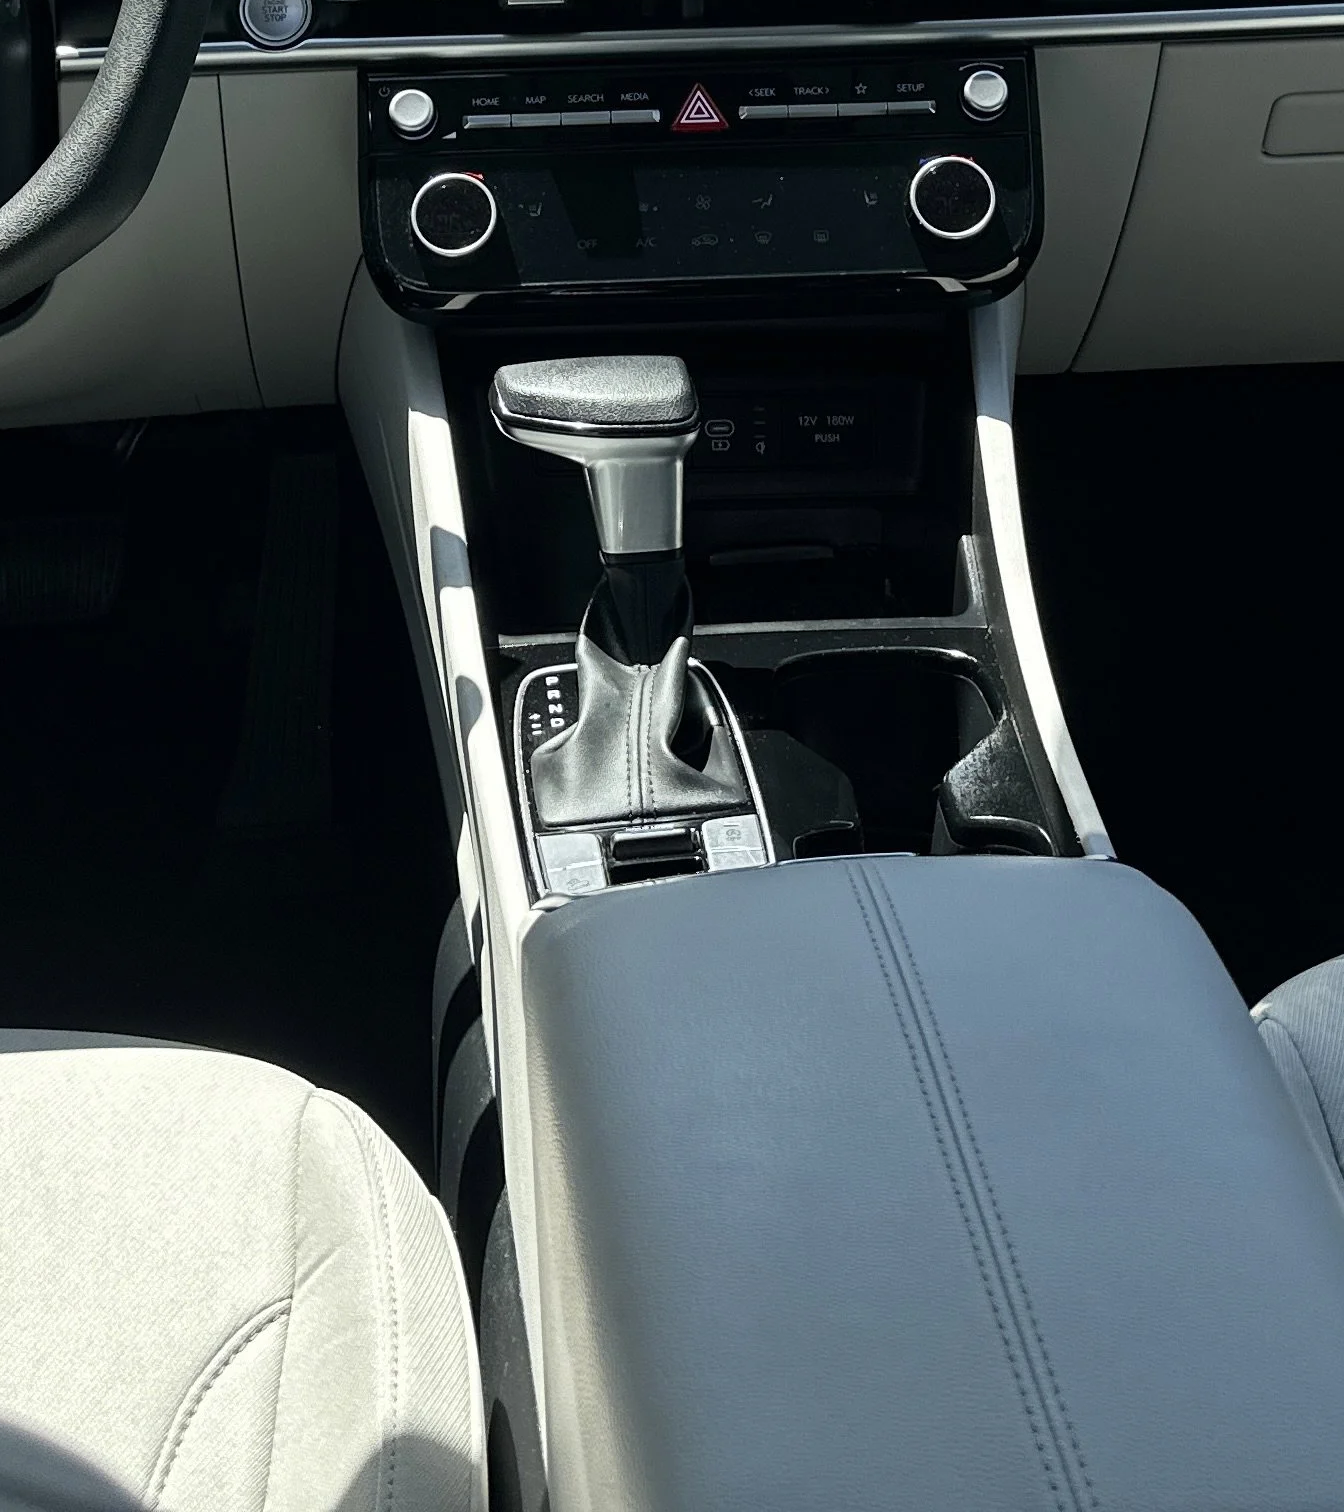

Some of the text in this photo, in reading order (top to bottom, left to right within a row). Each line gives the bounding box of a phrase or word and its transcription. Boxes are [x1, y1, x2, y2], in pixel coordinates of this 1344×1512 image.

[261, 5, 289, 14] START
[264, 13, 287, 23] STOP
[754, 87, 776, 97] SEEK
[793, 86, 824, 96] TRACK
[896, 83, 925, 93] SETUP
[472, 97, 500, 107] HOME
[525, 95, 547, 105] MAP
[567, 93, 605, 104] SEARCH
[620, 92, 650, 102] MEDIA
[576, 238, 598, 250] OFF
[636, 236, 657, 248] A/C
[798, 415, 855, 426] 12V 180W
[814, 433, 841, 443] PUSH
[548, 703, 563, 715] N
[550, 717, 565, 728] D
